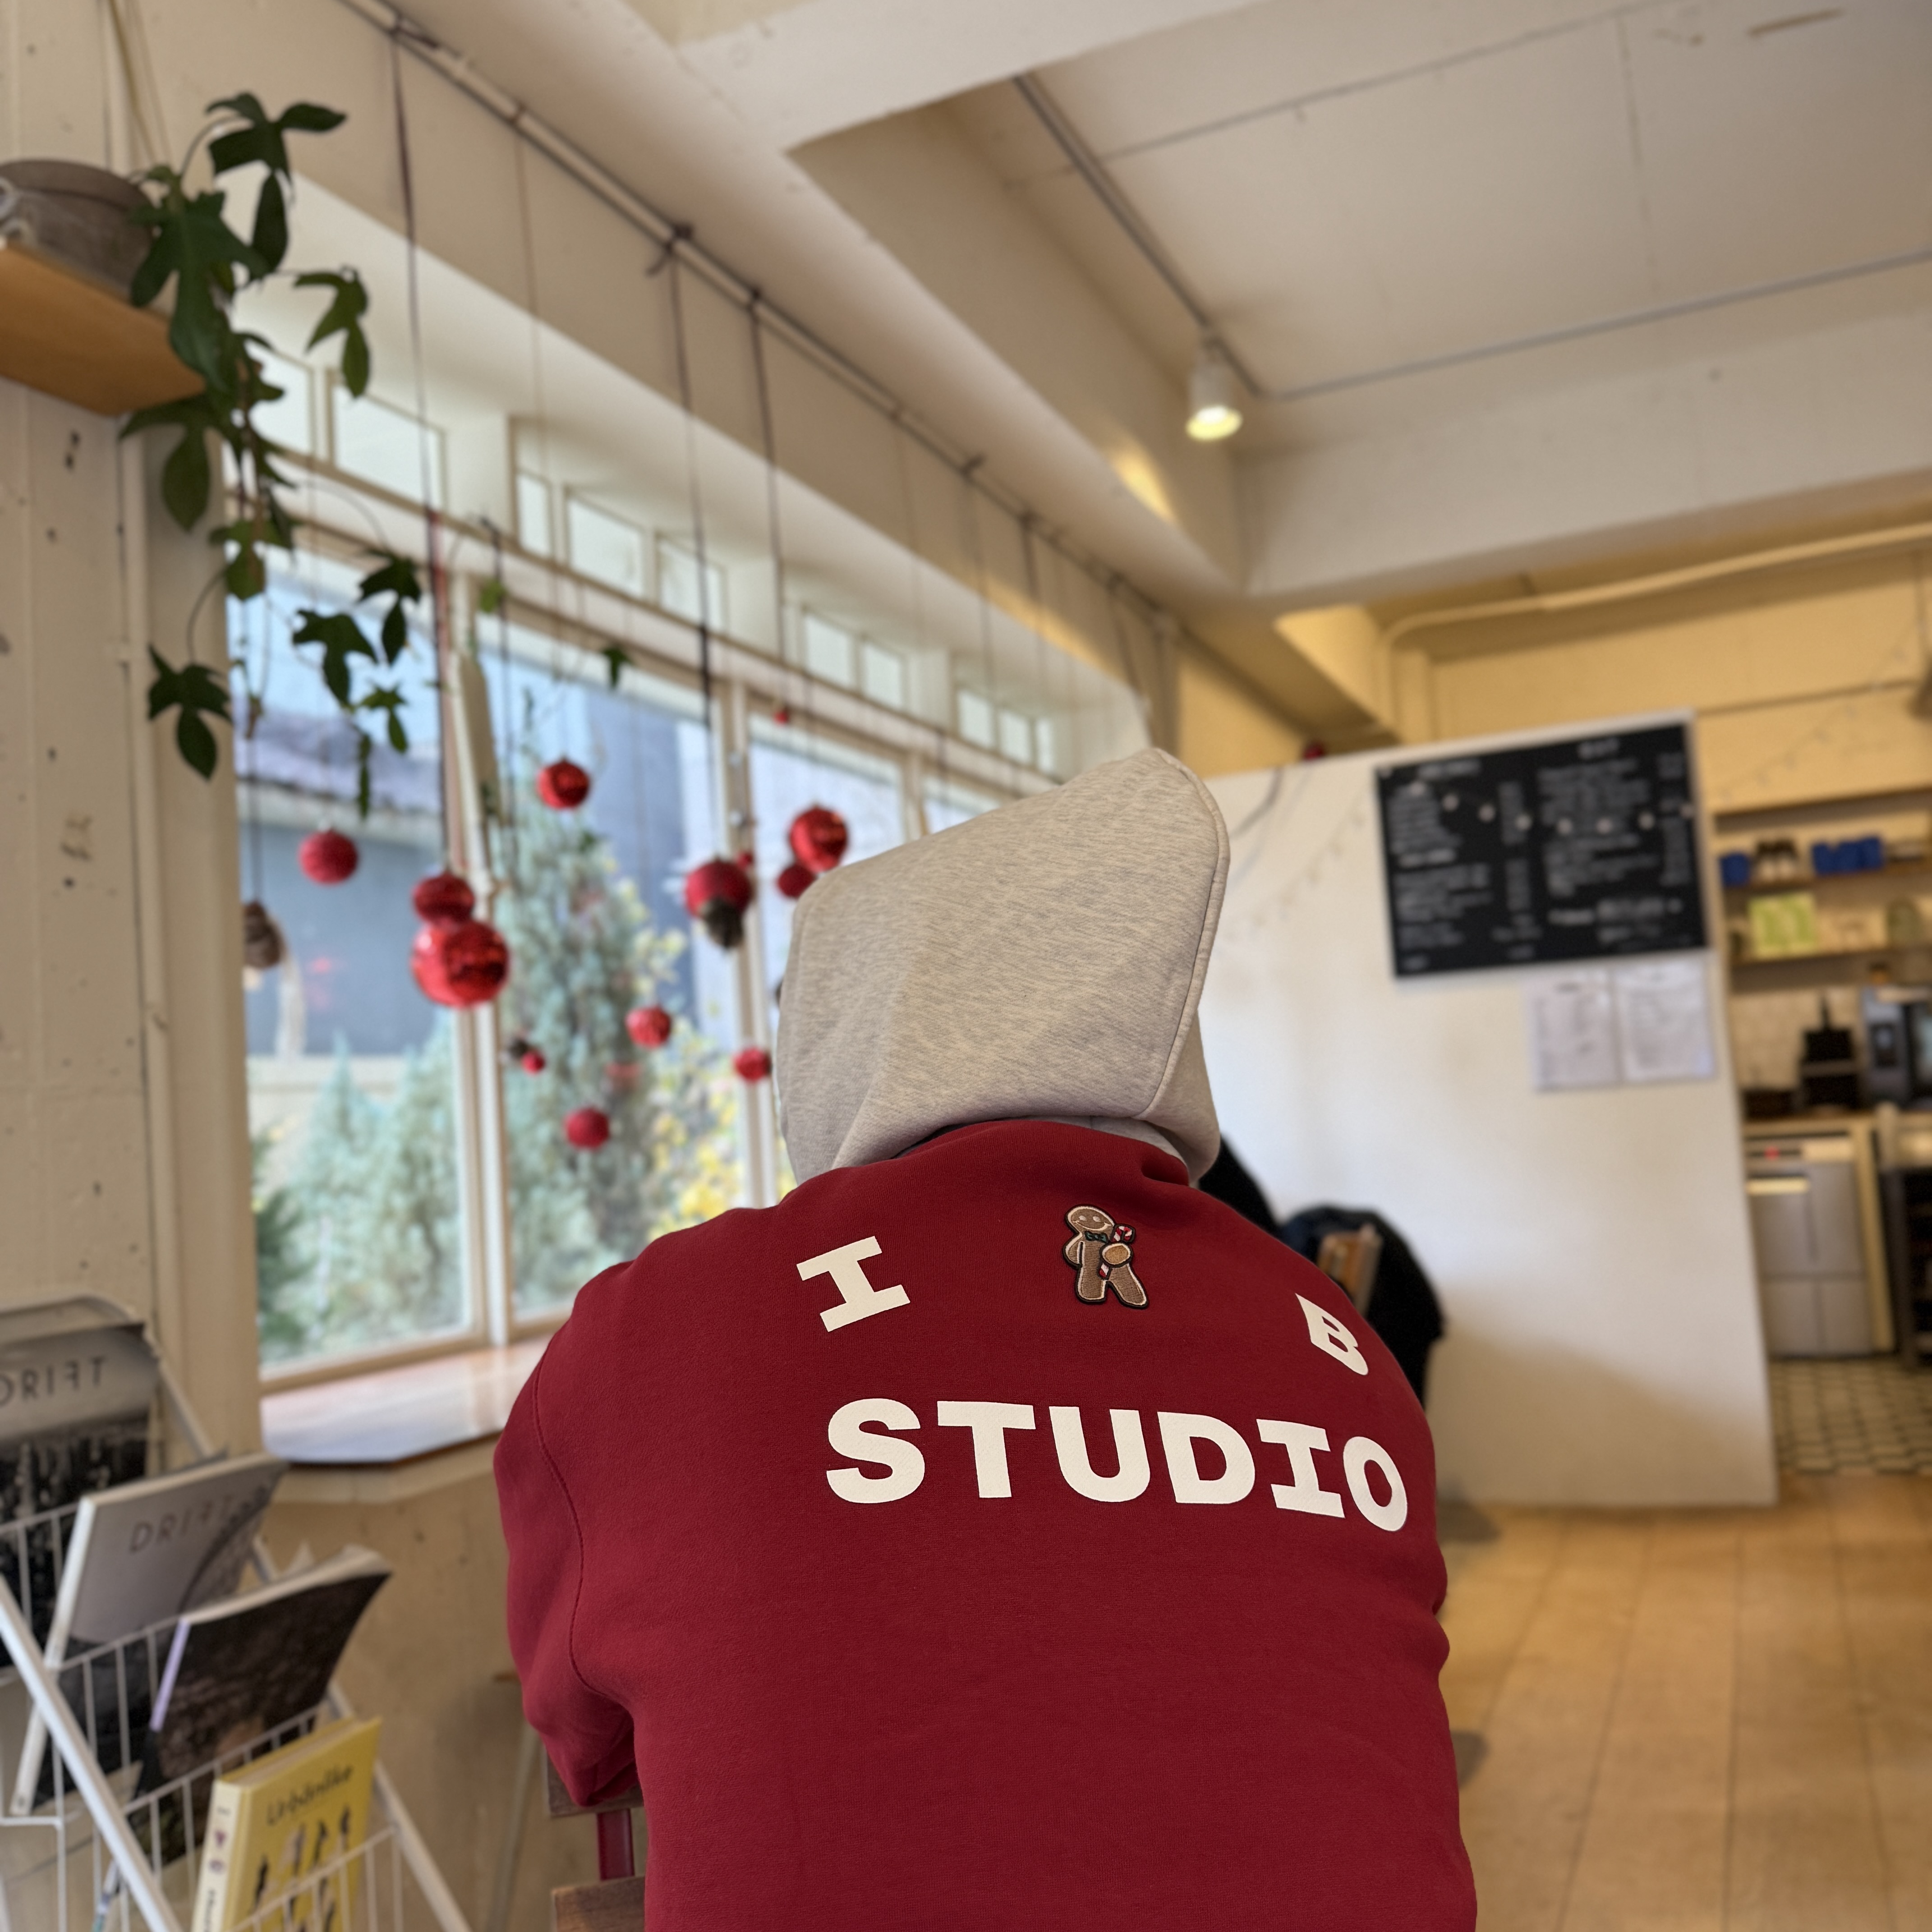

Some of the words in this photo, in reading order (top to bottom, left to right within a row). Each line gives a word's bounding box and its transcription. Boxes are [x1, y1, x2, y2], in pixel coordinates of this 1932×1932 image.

[796, 1236, 910, 1332] I
[1295, 1293, 1369, 1376] B
[826, 1398, 1408, 1532] STUDIO
